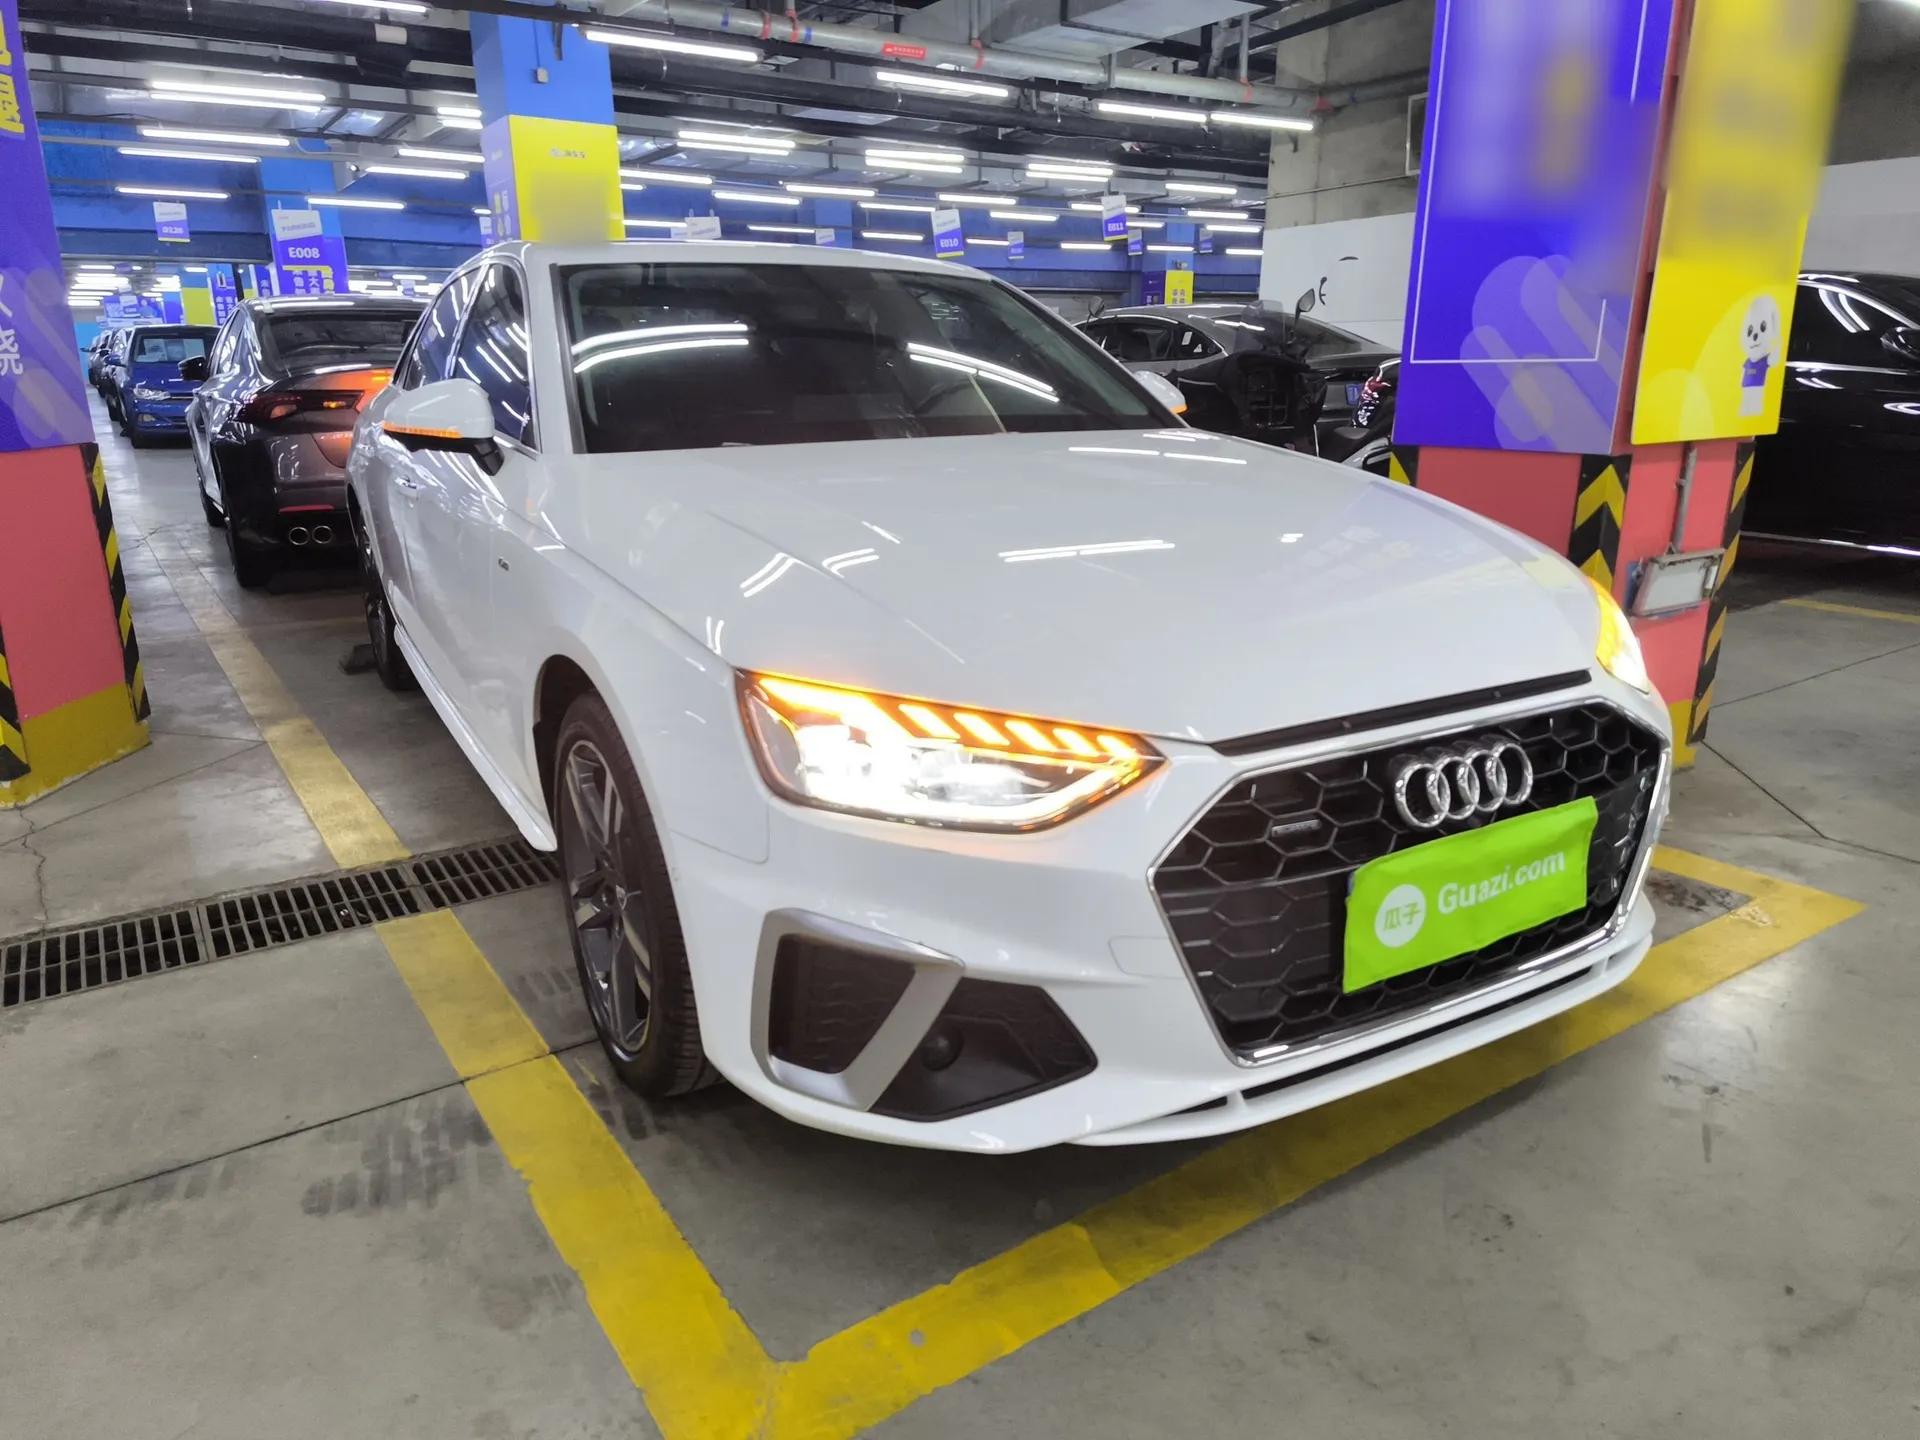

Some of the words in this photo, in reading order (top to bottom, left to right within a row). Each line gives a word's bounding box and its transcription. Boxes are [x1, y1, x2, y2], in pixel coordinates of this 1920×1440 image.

[287, 246, 321, 259] E008
[940, 238, 959, 248] E010
[1437, 850, 1566, 915] Guazi.com
[1382, 901, 1422, 932] 瓜子
